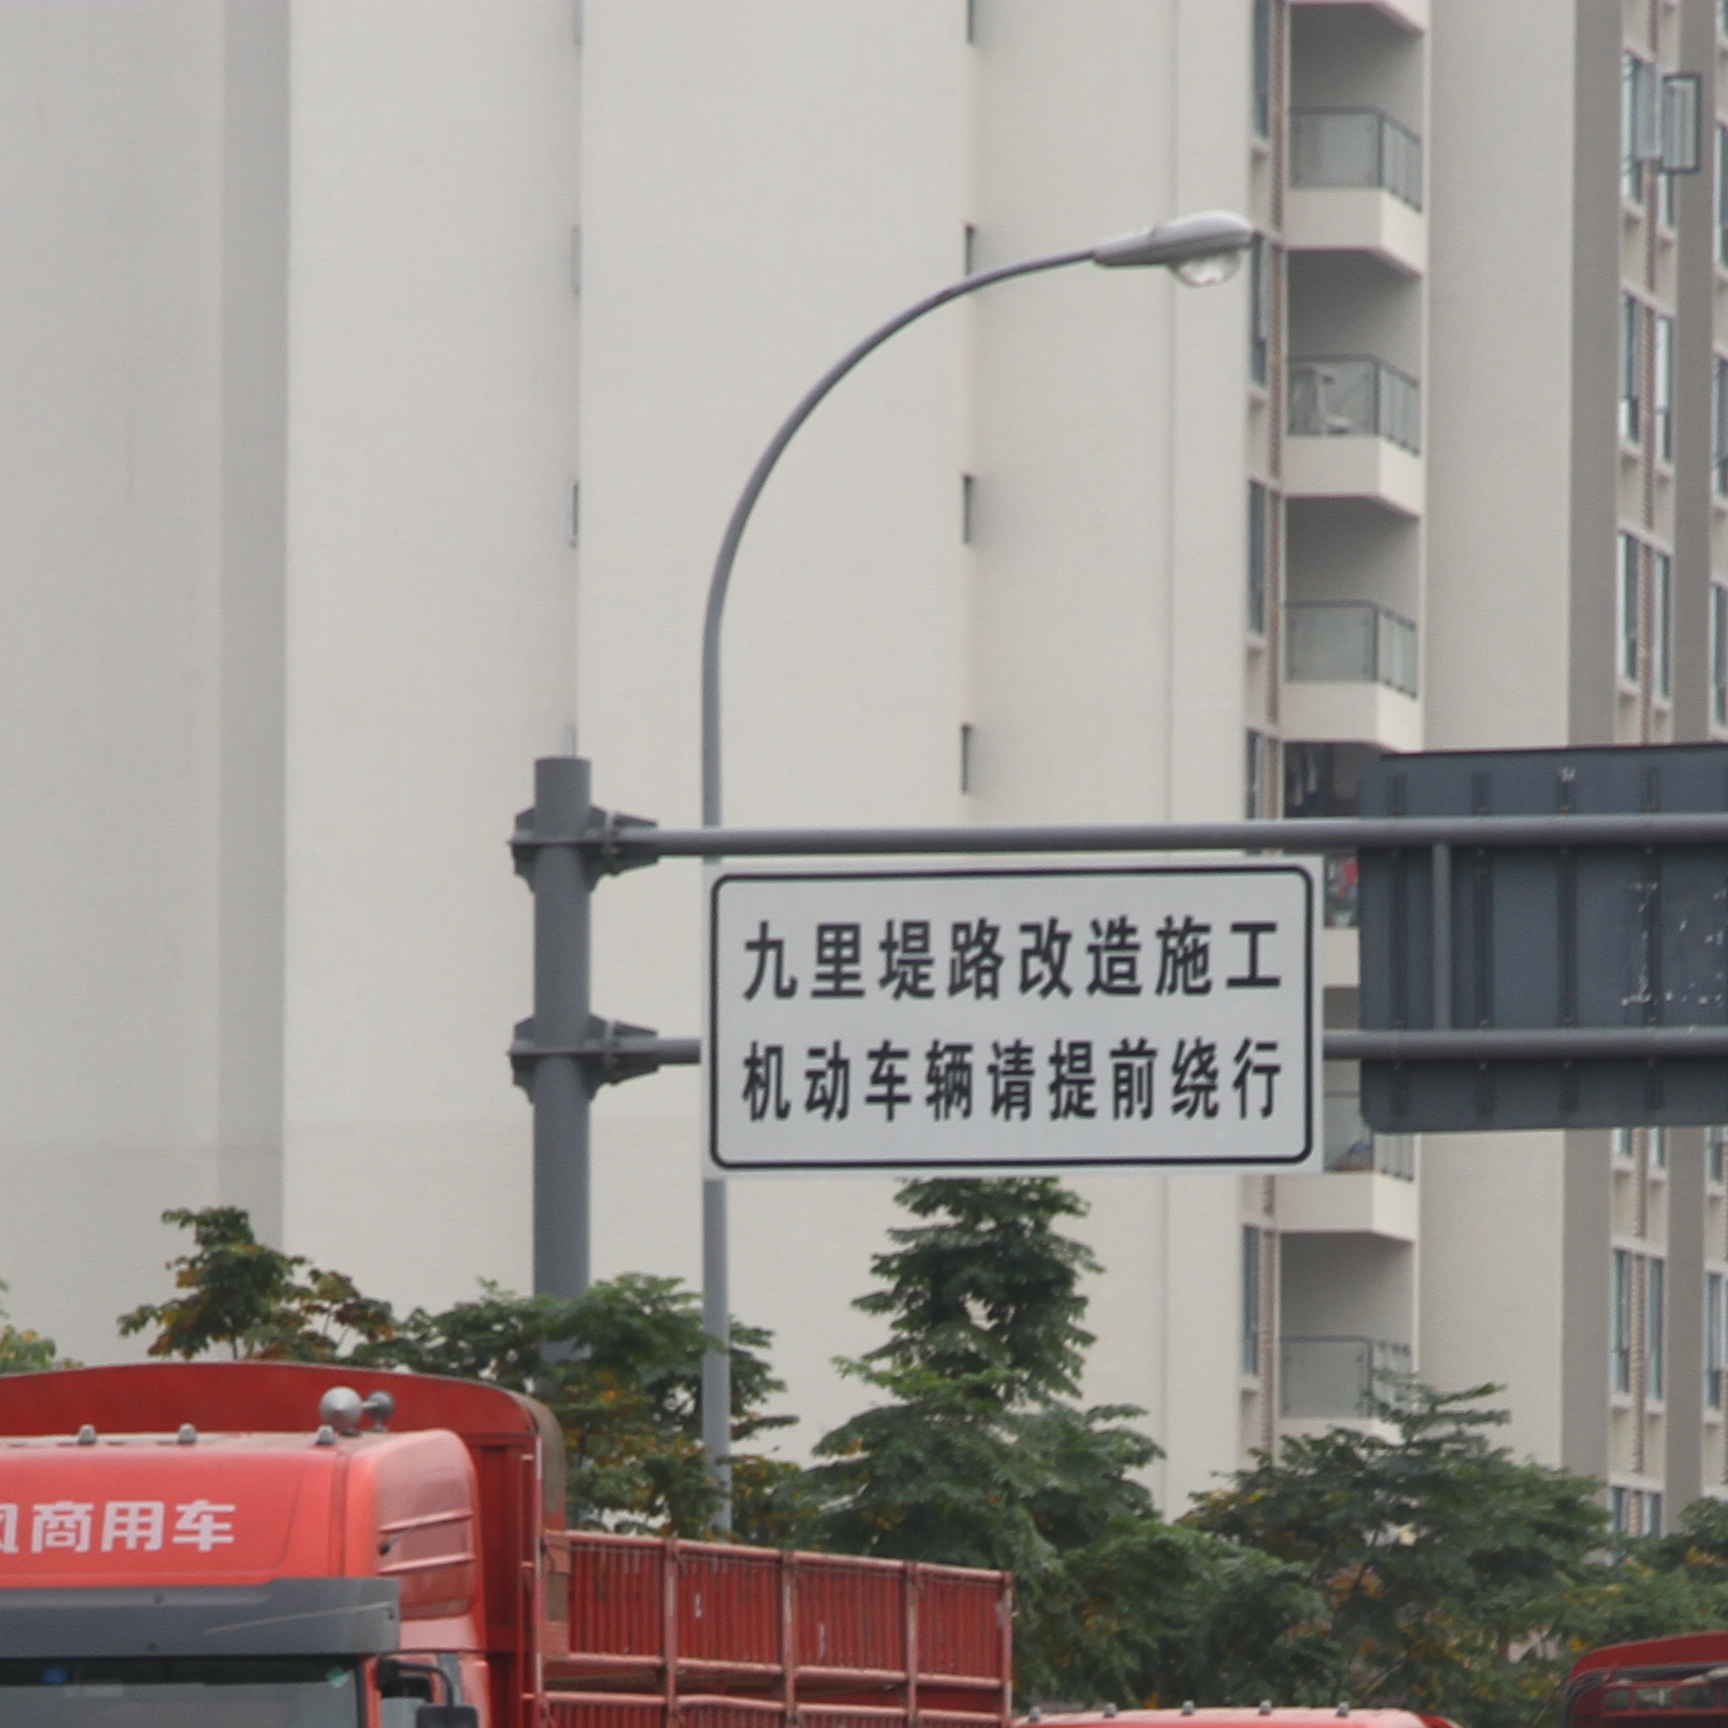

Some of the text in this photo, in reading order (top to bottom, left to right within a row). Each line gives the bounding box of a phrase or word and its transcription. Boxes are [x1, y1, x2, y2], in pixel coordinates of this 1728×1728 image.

[743, 916, 1282, 1000] 九里堤路改造施工
[742, 1036, 1282, 1122] 机动车辆请提前绕行
